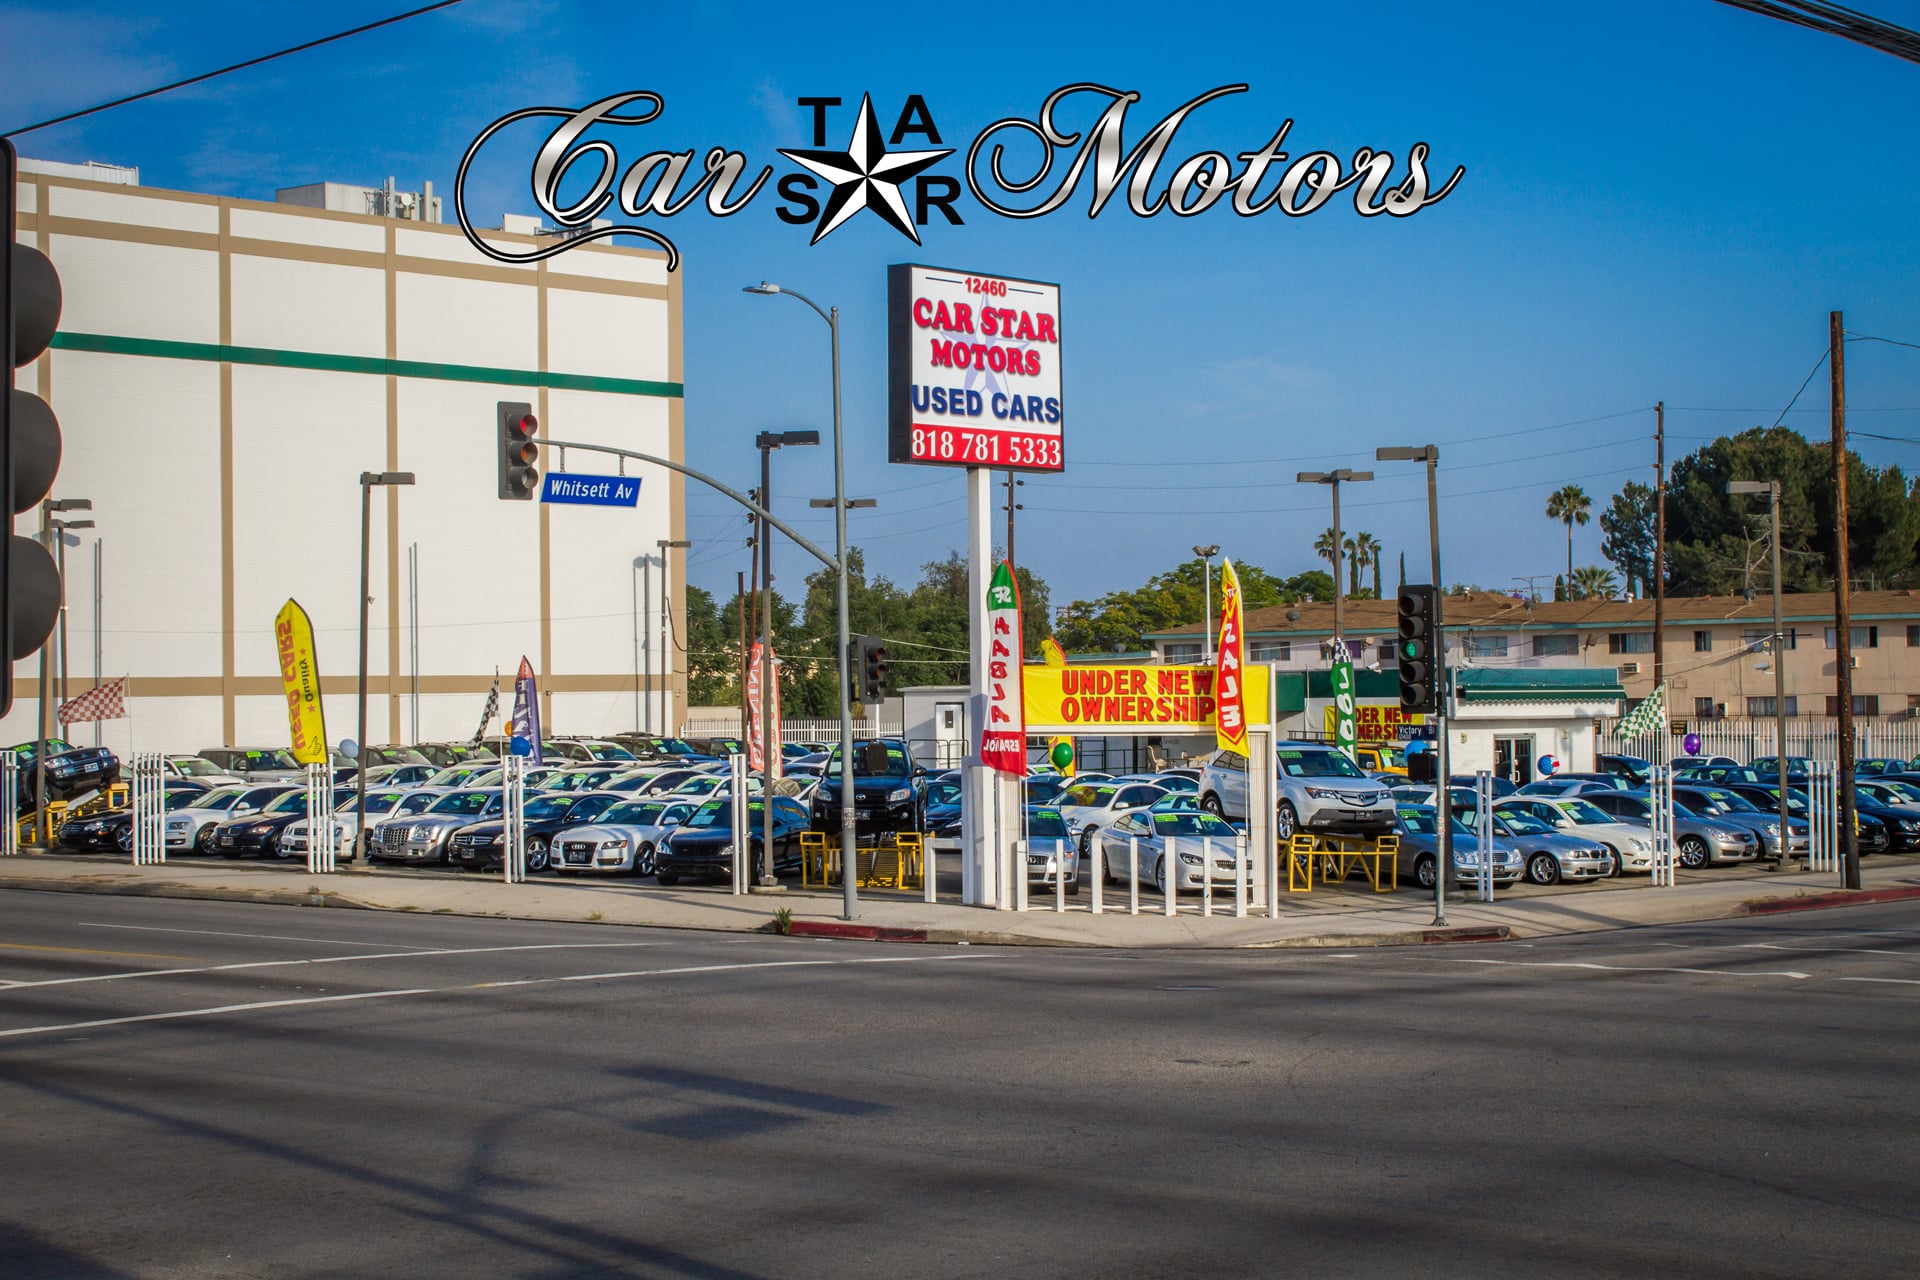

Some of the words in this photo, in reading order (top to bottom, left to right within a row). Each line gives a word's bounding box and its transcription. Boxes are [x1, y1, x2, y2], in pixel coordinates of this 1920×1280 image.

[965, 277, 1007, 297] 12460
[913, 297, 974, 333] CAR
[980, 306, 1057, 343] STAR
[930, 339, 1040, 376] MOTORS
[912, 385, 983, 416] USED
[991, 392, 1060, 424] CARS
[912, 428, 954, 459] 818
[961, 433, 1000, 461] 781
[1009, 436, 1061, 466] 5333
[551, 479, 610, 498] Whitsett
[614, 483, 633, 499] Av
[1062, 669, 1147, 696] UNDER
[1157, 669, 1215, 696] NEW
[1060, 696, 1216, 722] OWNERSHIP
[1398, 725, 1422, 737] Victory
